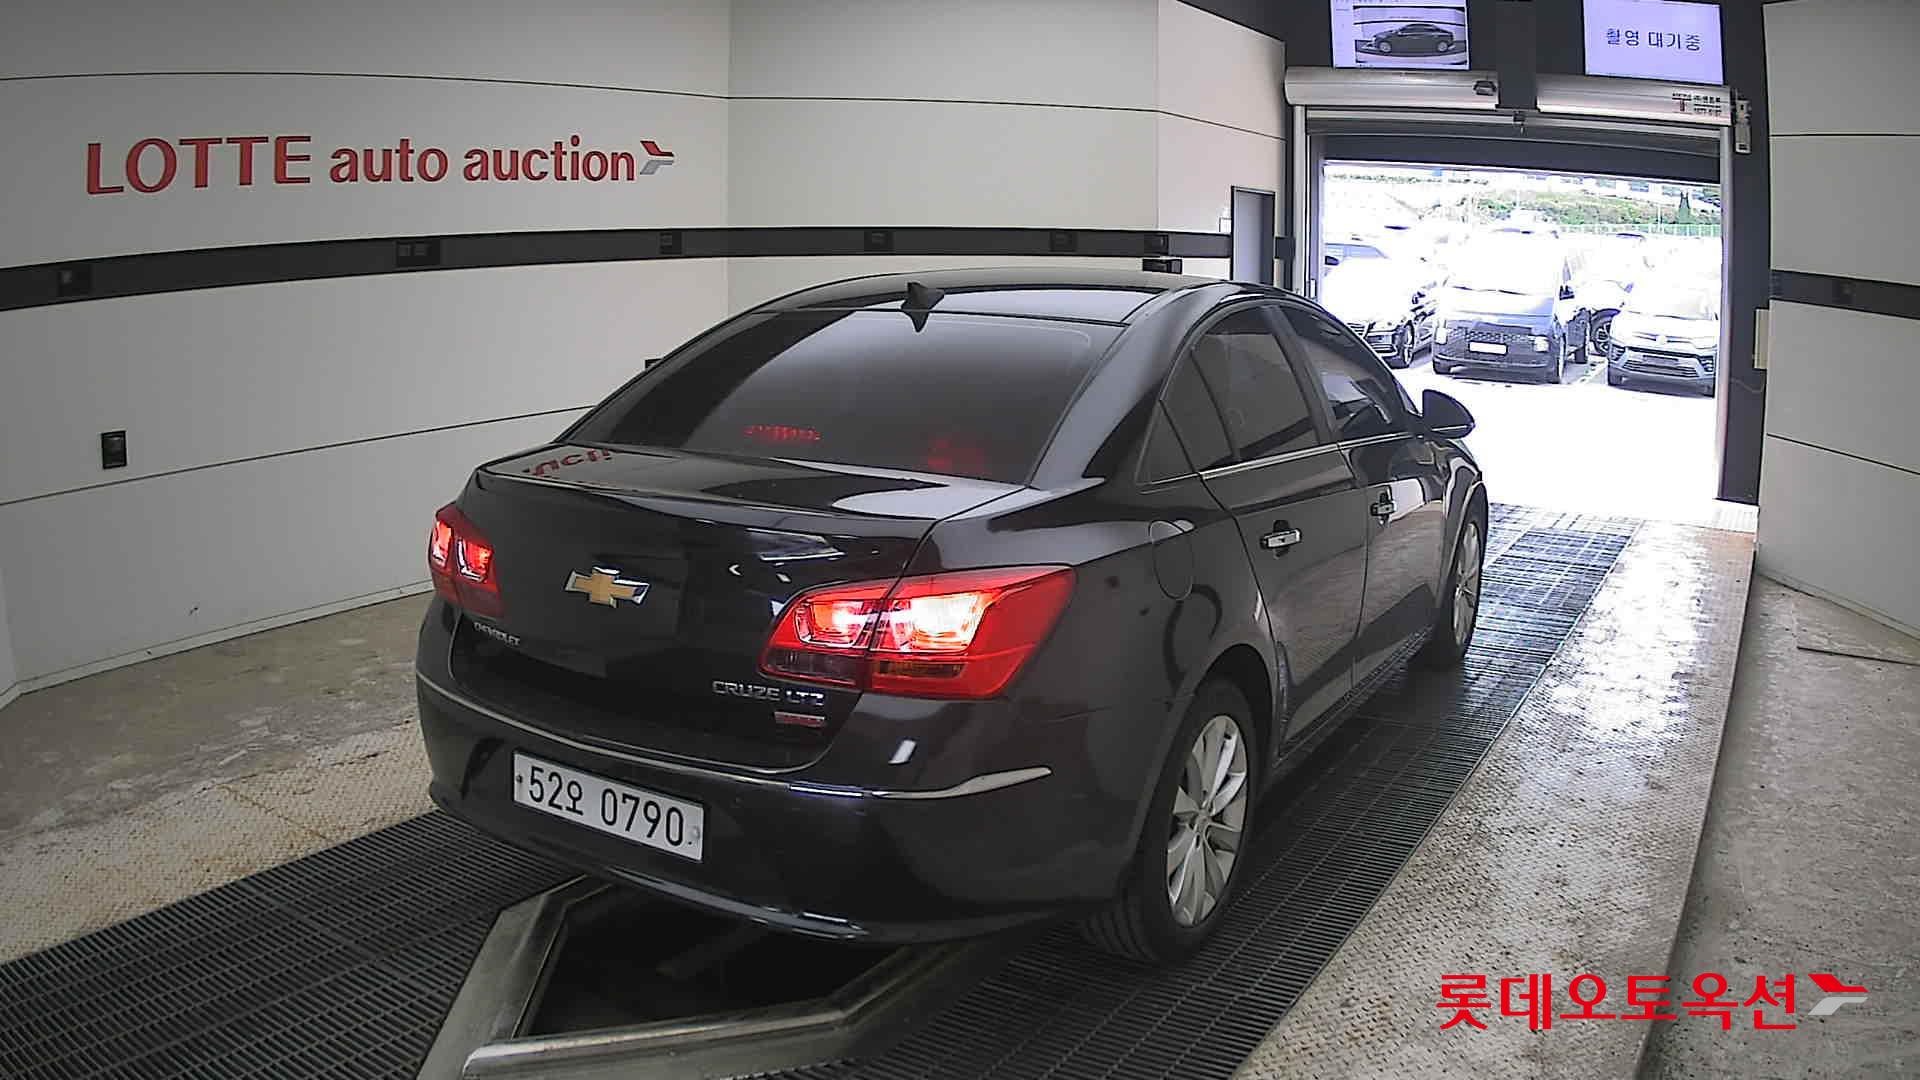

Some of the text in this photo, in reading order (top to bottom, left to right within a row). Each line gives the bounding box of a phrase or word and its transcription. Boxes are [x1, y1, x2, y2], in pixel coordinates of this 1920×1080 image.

[1606, 28, 1640, 47] 촬영
[87, 135, 636, 195] LOTTE auto auction
[712, 680, 825, 706] CRUZE LTZ
[529, 766, 684, 846] 52오 0790
